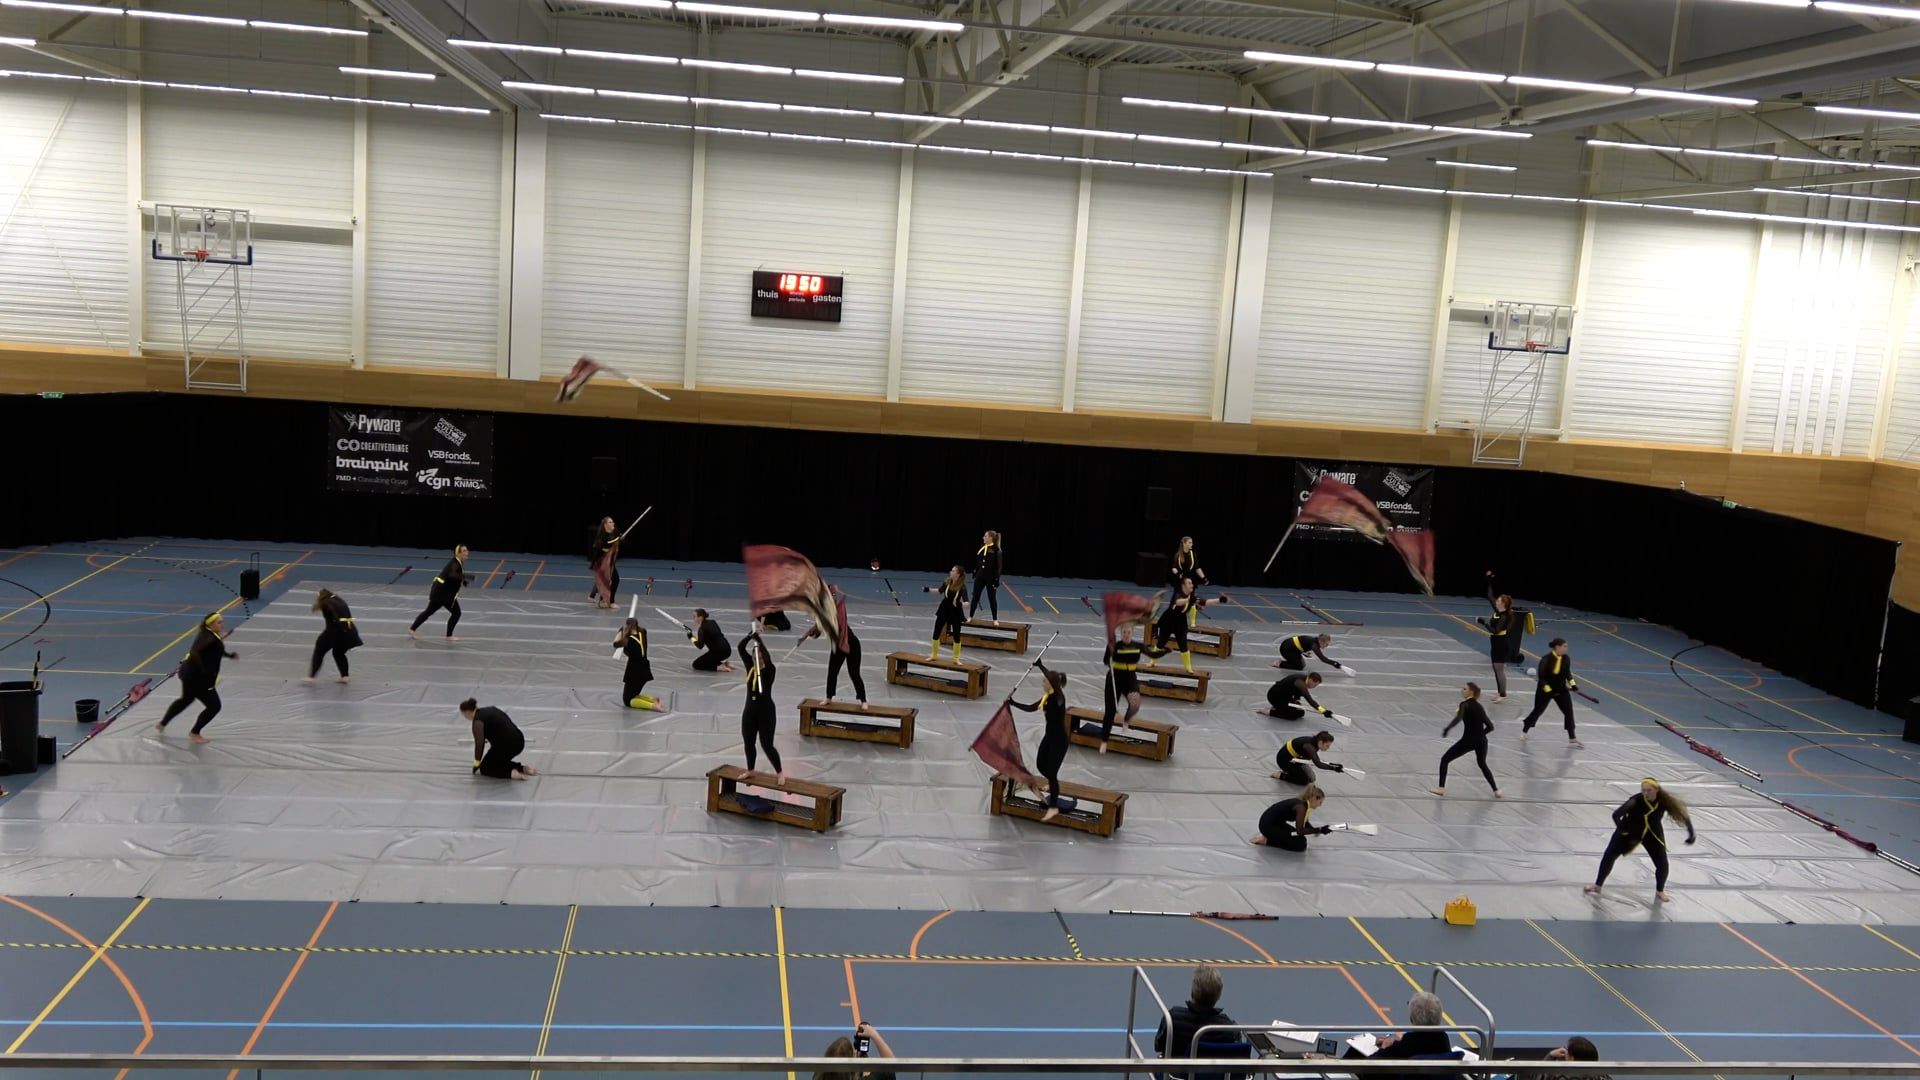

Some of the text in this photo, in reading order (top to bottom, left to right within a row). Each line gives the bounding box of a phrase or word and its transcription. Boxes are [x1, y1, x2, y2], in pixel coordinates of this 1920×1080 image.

[757, 288, 779, 299] thuis
[812, 293, 842, 303] gasten
[358, 414, 402, 434] Pyware
[336, 455, 409, 472] brainpink
[426, 477, 451, 490] cgn
